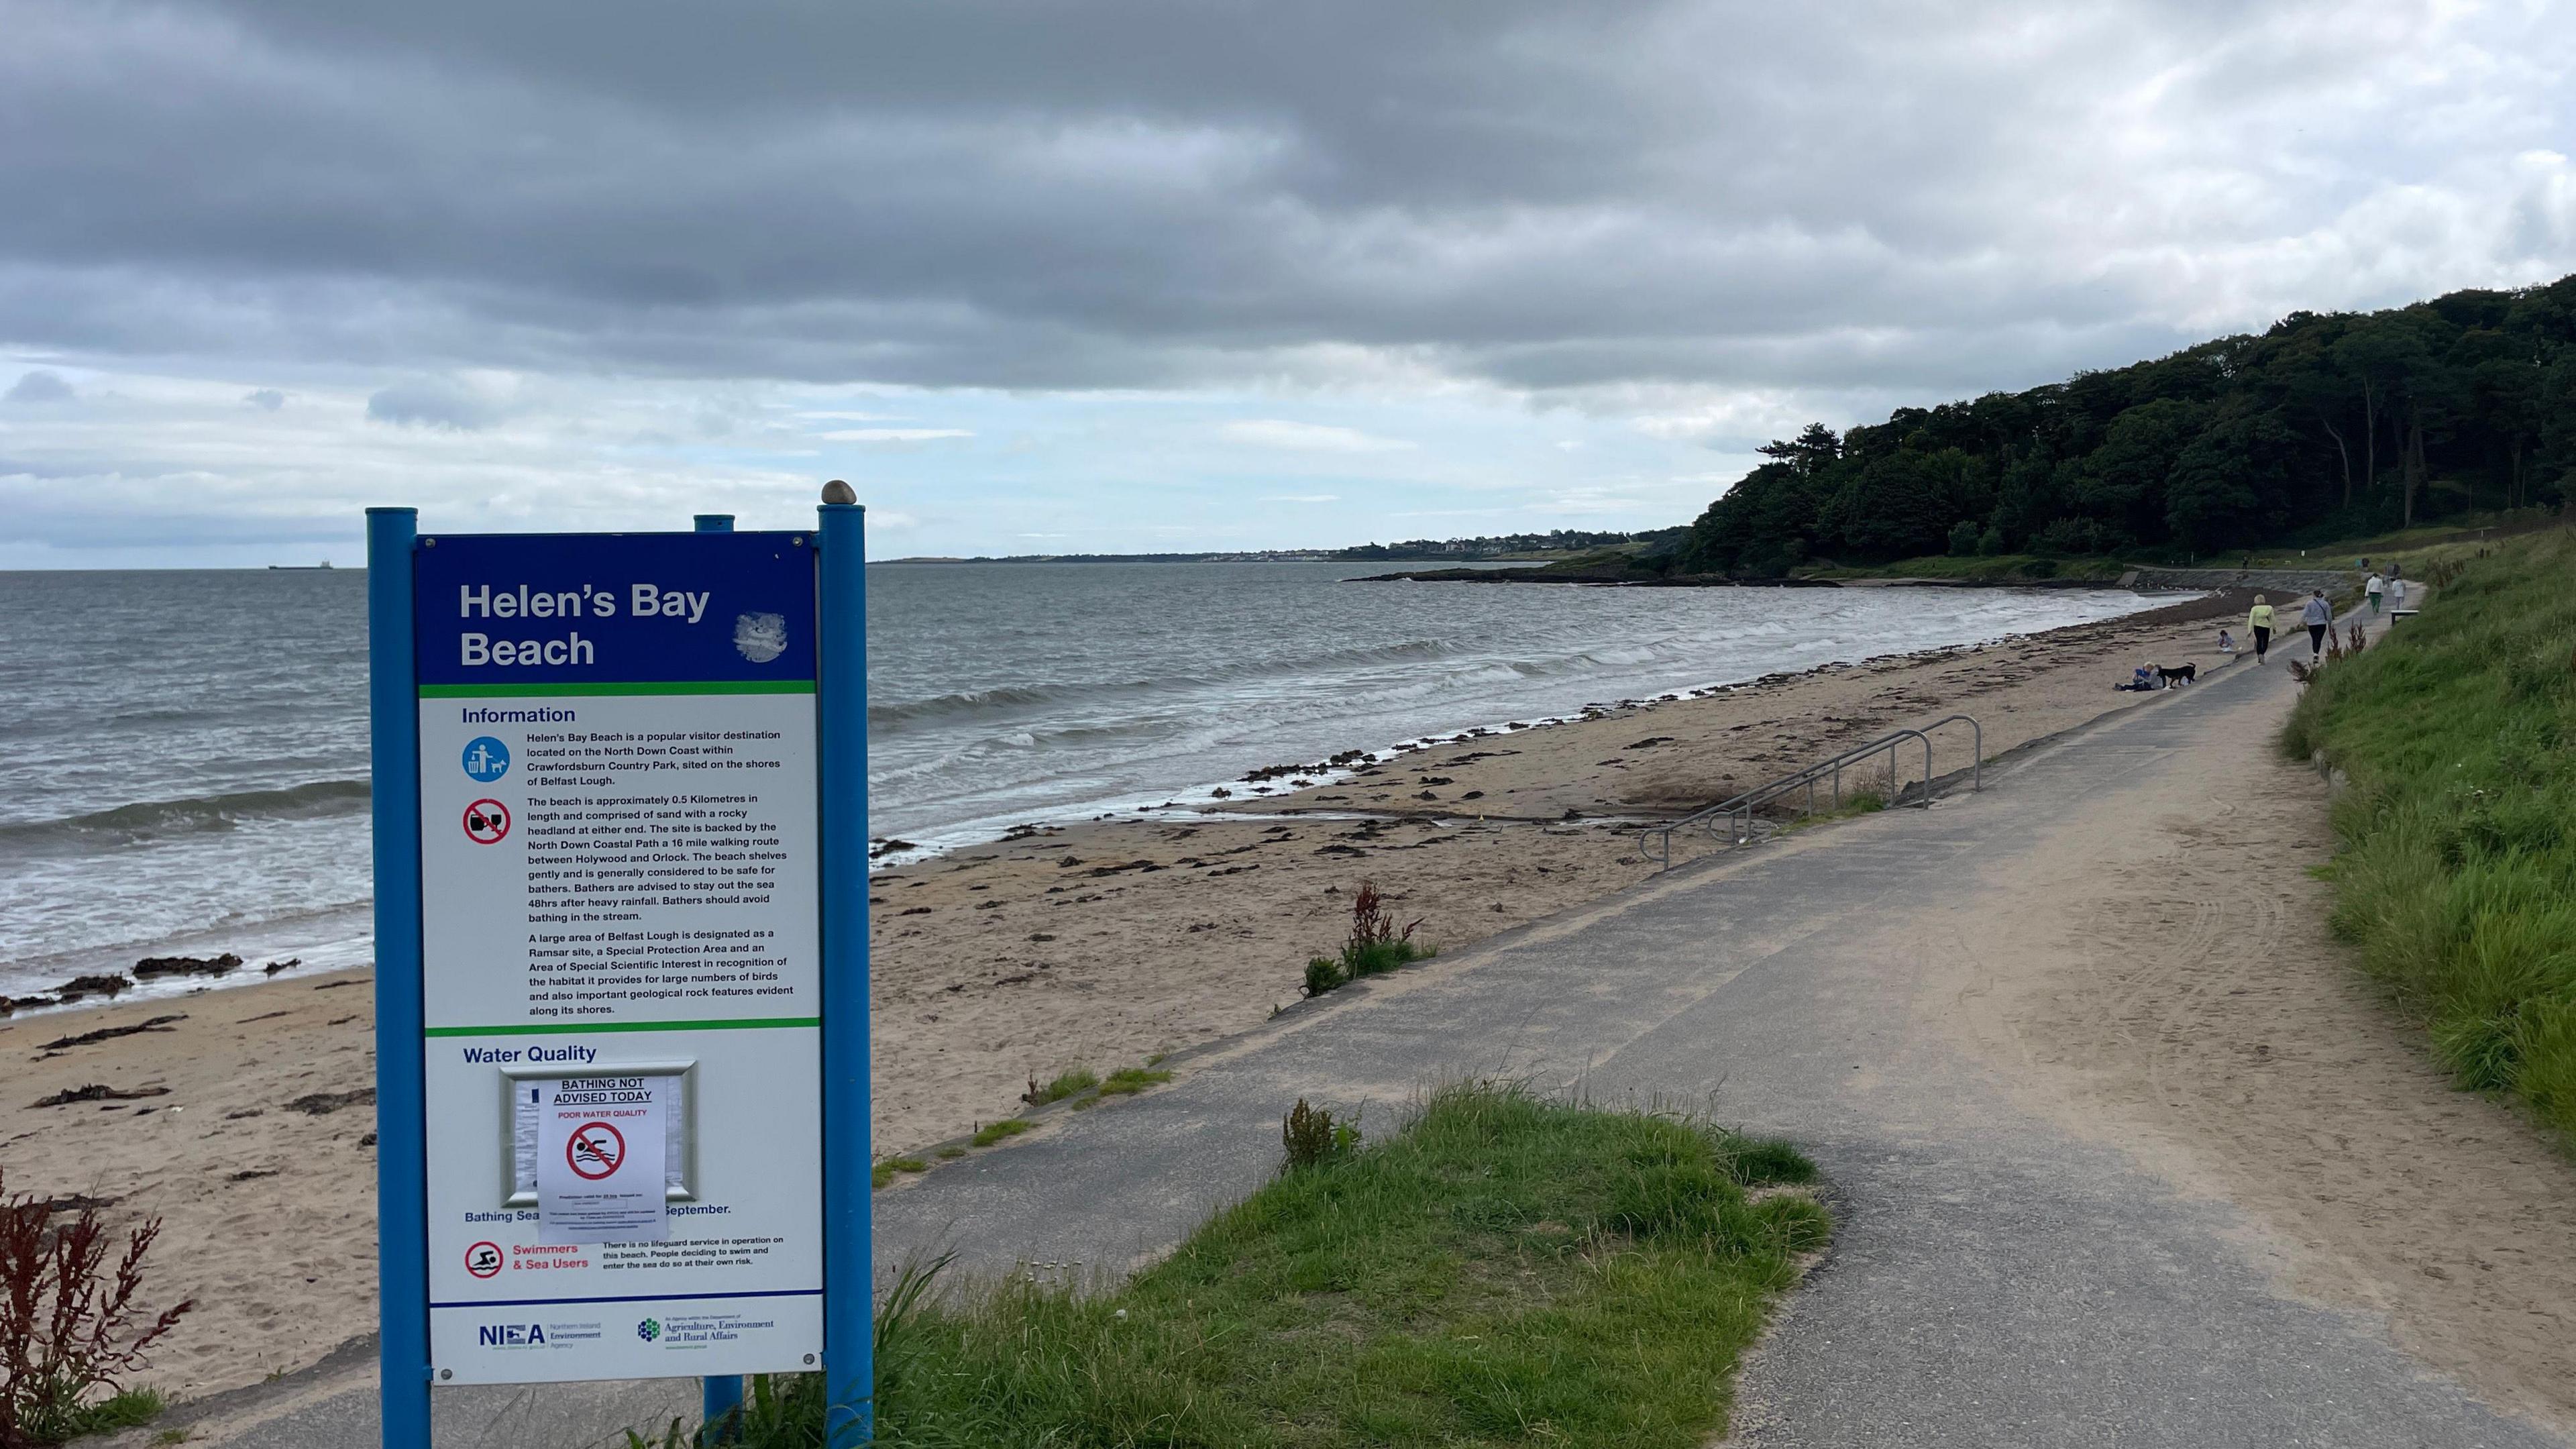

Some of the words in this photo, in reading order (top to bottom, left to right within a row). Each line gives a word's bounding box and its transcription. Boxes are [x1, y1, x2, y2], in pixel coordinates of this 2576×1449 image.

[461, 584, 615, 617] Helen's
[632, 584, 710, 623] Bay
[462, 631, 593, 665] Beach
[463, 706, 575, 723] Information
[527, 733, 564, 742] Helen's
[568, 733, 587, 743] Bay
[590, 733, 623, 741] Beach
[626, 733, 635, 741] is
[647, 732, 686, 743] popular
[689, 731, 720, 740] visitor
[723, 731, 780, 739] destination
[527, 747, 565, 757] located
[584, 747, 601, 756] the
[604, 747, 633, 755] North
[637, 747, 665, 755] Down
[669, 746, 699, 755] Coast
[702, 745, 733, 754] within
[527, 762, 605, 771] Crawfordsburn
[608, 761, 649, 771] Country
[653, 761, 679, 770] Park,
[682, 760, 707, 769] sited
[726, 760, 743, 768] the
[745, 759, 780, 768] shores
[527, 777, 537, 786] of
[541, 777, 577, 786] Belfast
[580, 776, 614, 786] Lough.
[527, 798, 546, 806] The
[550, 797, 581, 806] beach
[584, 797, 593, 805] is
[596, 796, 669, 806] approximately
[672, 795, 687, 804] 0.5
[690, 795, 745, 804] Kilometres
[749, 794, 757, 802] in
[527, 812, 559, 822] length
[563, 811, 582, 820] and
[586, 810, 640, 821] comprised
[643, 810, 653, 818] of
[656, 810, 682, 818] sand
[684, 810, 706, 818] with
[718, 808, 747, 818] rocky
[528, 841, 557, 850] North
[561, 841, 590, 849] Down
[593, 839, 632, 849] Coastal
[636, 839, 659, 847] Path
[672, 839, 683, 847] 16
[686, 838, 707, 847] mile
[710, 837, 749, 847] walking
[753, 837, 779, 845] route
[528, 856, 572, 864] between
[576, 854, 627, 865] Holywood
[630, 853, 649, 862] and
[652, 853, 689, 862] Orlock.
[692, 853, 712, 861] The
[714, 852, 745, 861] beach
[749, 851, 787, 860] shelves
[528, 884, 570, 893] bathers.
[574, 883, 614, 892] Bathers
[637, 881, 677, 891] advised
[680, 882, 690, 890] to
[693, 881, 714, 891] stay
[718, 881, 734, 890] out
[737, 880, 753, 889] the
[528, 899, 557, 908] 48hrs
[561, 898, 585, 907] after
[588, 898, 619, 908] heavy
[621, 896, 659, 906] rainfall.
[663, 896, 702, 905] Bathers
[706, 895, 739, 904] should
[743, 894, 769, 903] avoid
[529, 913, 568, 923] bathing
[571, 913, 580, 921] in
[583, 912, 600, 921] the
[602, 912, 641, 920] stream.
[529, 934, 536, 943] A
[539, 934, 566, 944] large
[594, 932, 604, 941] of
[608, 932, 644, 941] Belfast
[647, 931, 679, 941] Lough
[682, 930, 690, 939] is
[694, 929, 750, 940] designated
[529, 949, 569, 957] Ramsar
[572, 947, 593, 957] site,
[606, 946, 643, 957] Special
[647, 945, 700, 954] Protection
[703, 945, 727, 953] Area
[730, 944, 749, 953] and
[529, 963, 553, 971] Area
[556, 963, 566, 971] of
[570, 961, 607, 972] Special
[610, 961, 658, 969] Scientific
[661, 960, 701, 969] Interest
[704, 959, 712, 967] in
[716, 957, 773, 969] recognition
[777, 957, 787, 965] of
[529, 991, 548, 1001] and
[551, 991, 573, 1000] also
[576, 990, 627, 1001] important
[630, 988, 682, 1000] geological
[686, 987, 708, 996] rock
[711, 987, 753, 996] features
[756, 986, 794, 995] evident
[529, 1006, 557, 1016] along
[561, 1006, 574, 1014] its
[577, 1005, 614, 1014] shores.
[463, 1048, 522, 1063] Water
[527, 1045, 596, 1063] Quality
[561, 1079, 616, 1089] BATHING
[619, 1078, 644, 1088] NOT
[553, 1092, 606, 1104] ADVISED
[610, 1091, 652, 1102] TODAY
[465, 1212, 513, 1223] Bathing
[517, 1210, 539, 1220] Sea
[651, 1239, 687, 1248] lifeguard
[731, 1237, 771, 1246] operation
[513, 1244, 578, 1255] Swimmers
[513, 1260, 522, 1270] &
[526, 1259, 549, 1269] Sea
[553, 1258, 588, 1269] Users
[665, 1322, 716, 1334] Agriculture,
[718, 1320, 774, 1330] Environment
[550, 1332, 601, 1340] Environment
[665, 1333, 681, 1342] and
[684, 1332, 708, 1342] Rural
[710, 1332, 738, 1340] Affairs
